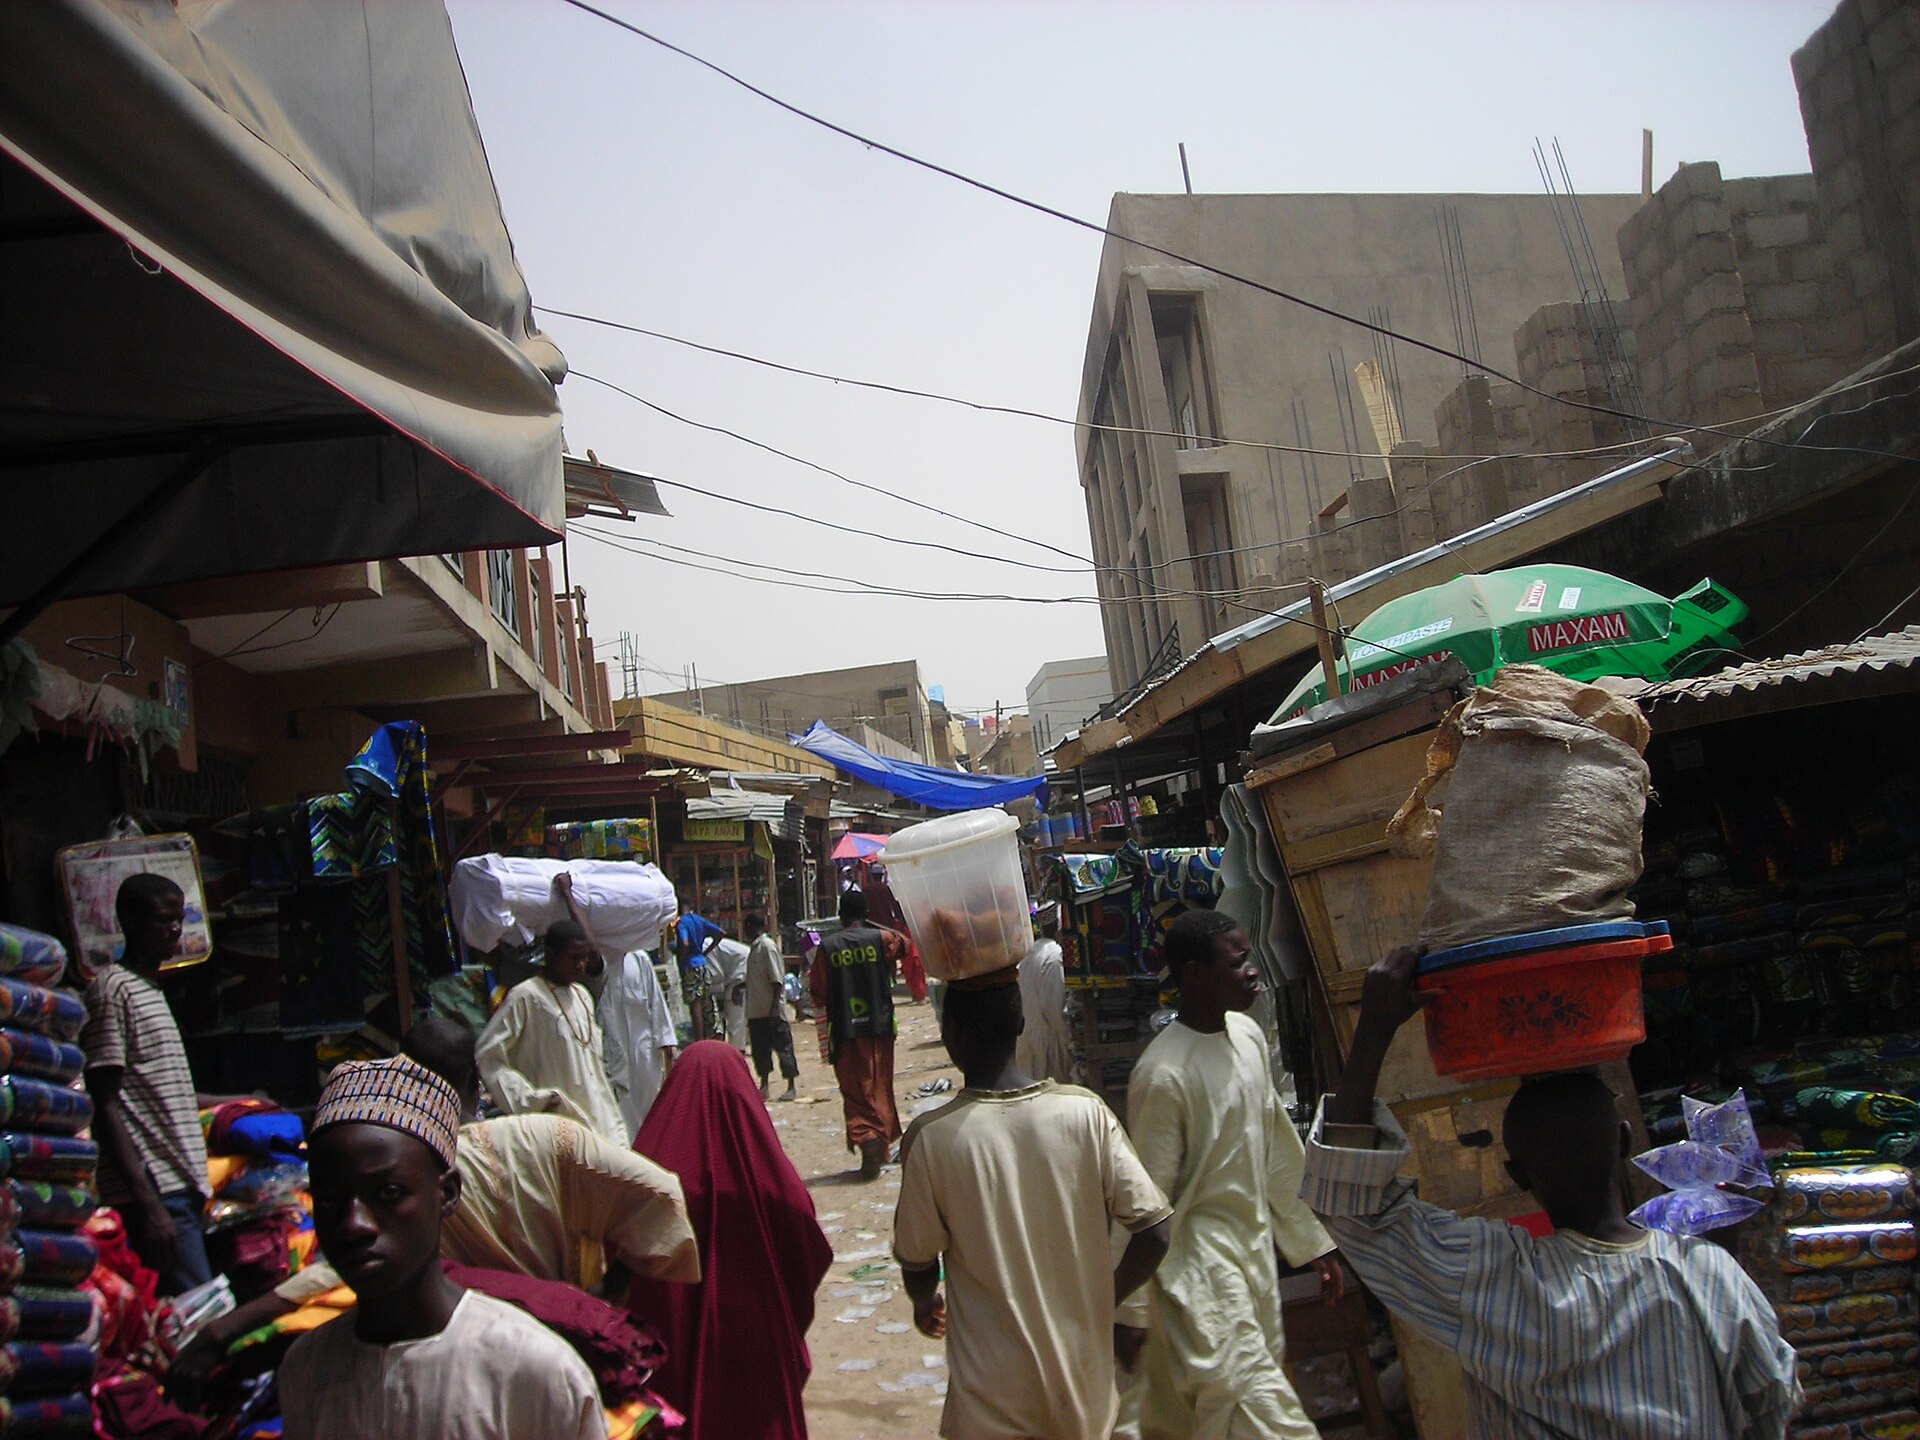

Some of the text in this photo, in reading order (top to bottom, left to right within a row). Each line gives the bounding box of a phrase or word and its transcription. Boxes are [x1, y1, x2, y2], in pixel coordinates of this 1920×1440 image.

[1353, 618, 1451, 659] TOOTHPASTE
[1531, 613, 1626, 651] MAXAM
[831, 944, 877, 967] 0809
